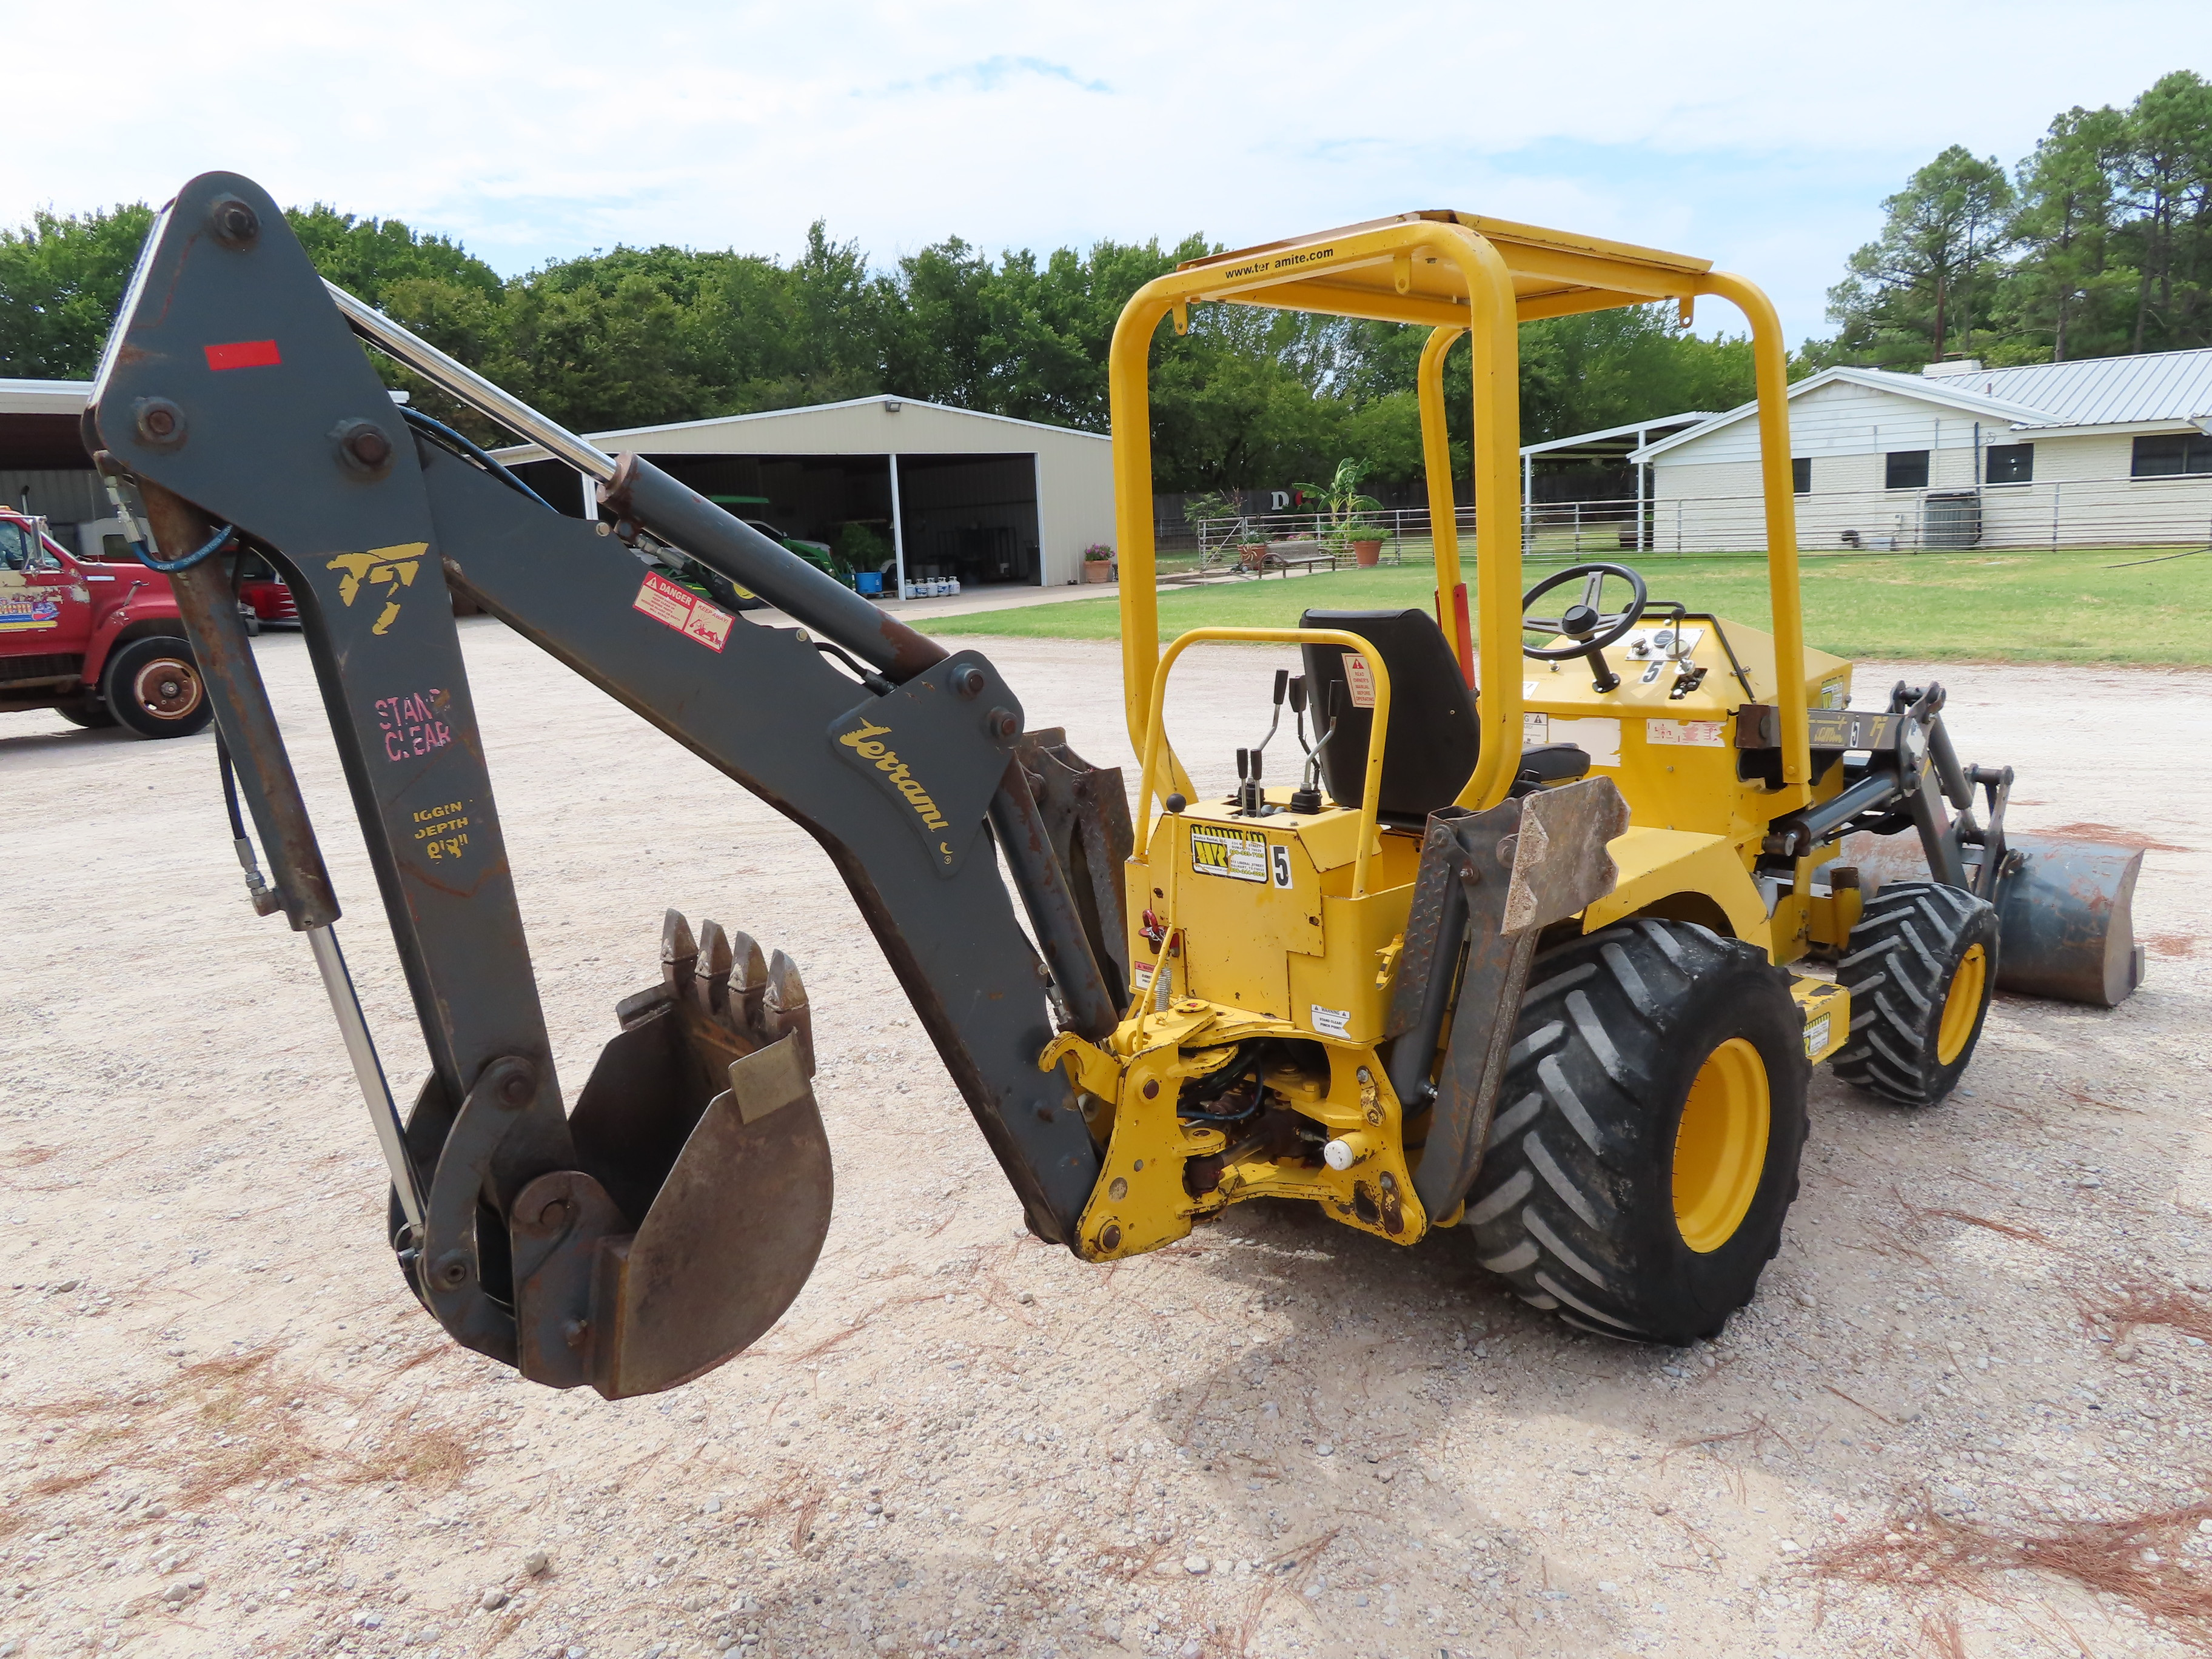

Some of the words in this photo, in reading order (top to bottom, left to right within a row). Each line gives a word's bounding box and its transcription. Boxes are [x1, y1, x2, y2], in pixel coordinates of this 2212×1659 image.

[1225, 248, 1333, 279] www.teramite.com
[660, 582, 692, 606] DANGER
[698, 605, 712, 614] KEEP
[712, 612, 729, 624] AWAY!
[1643, 661, 1663, 682] 5
[1273, 846, 1289, 886] 5
